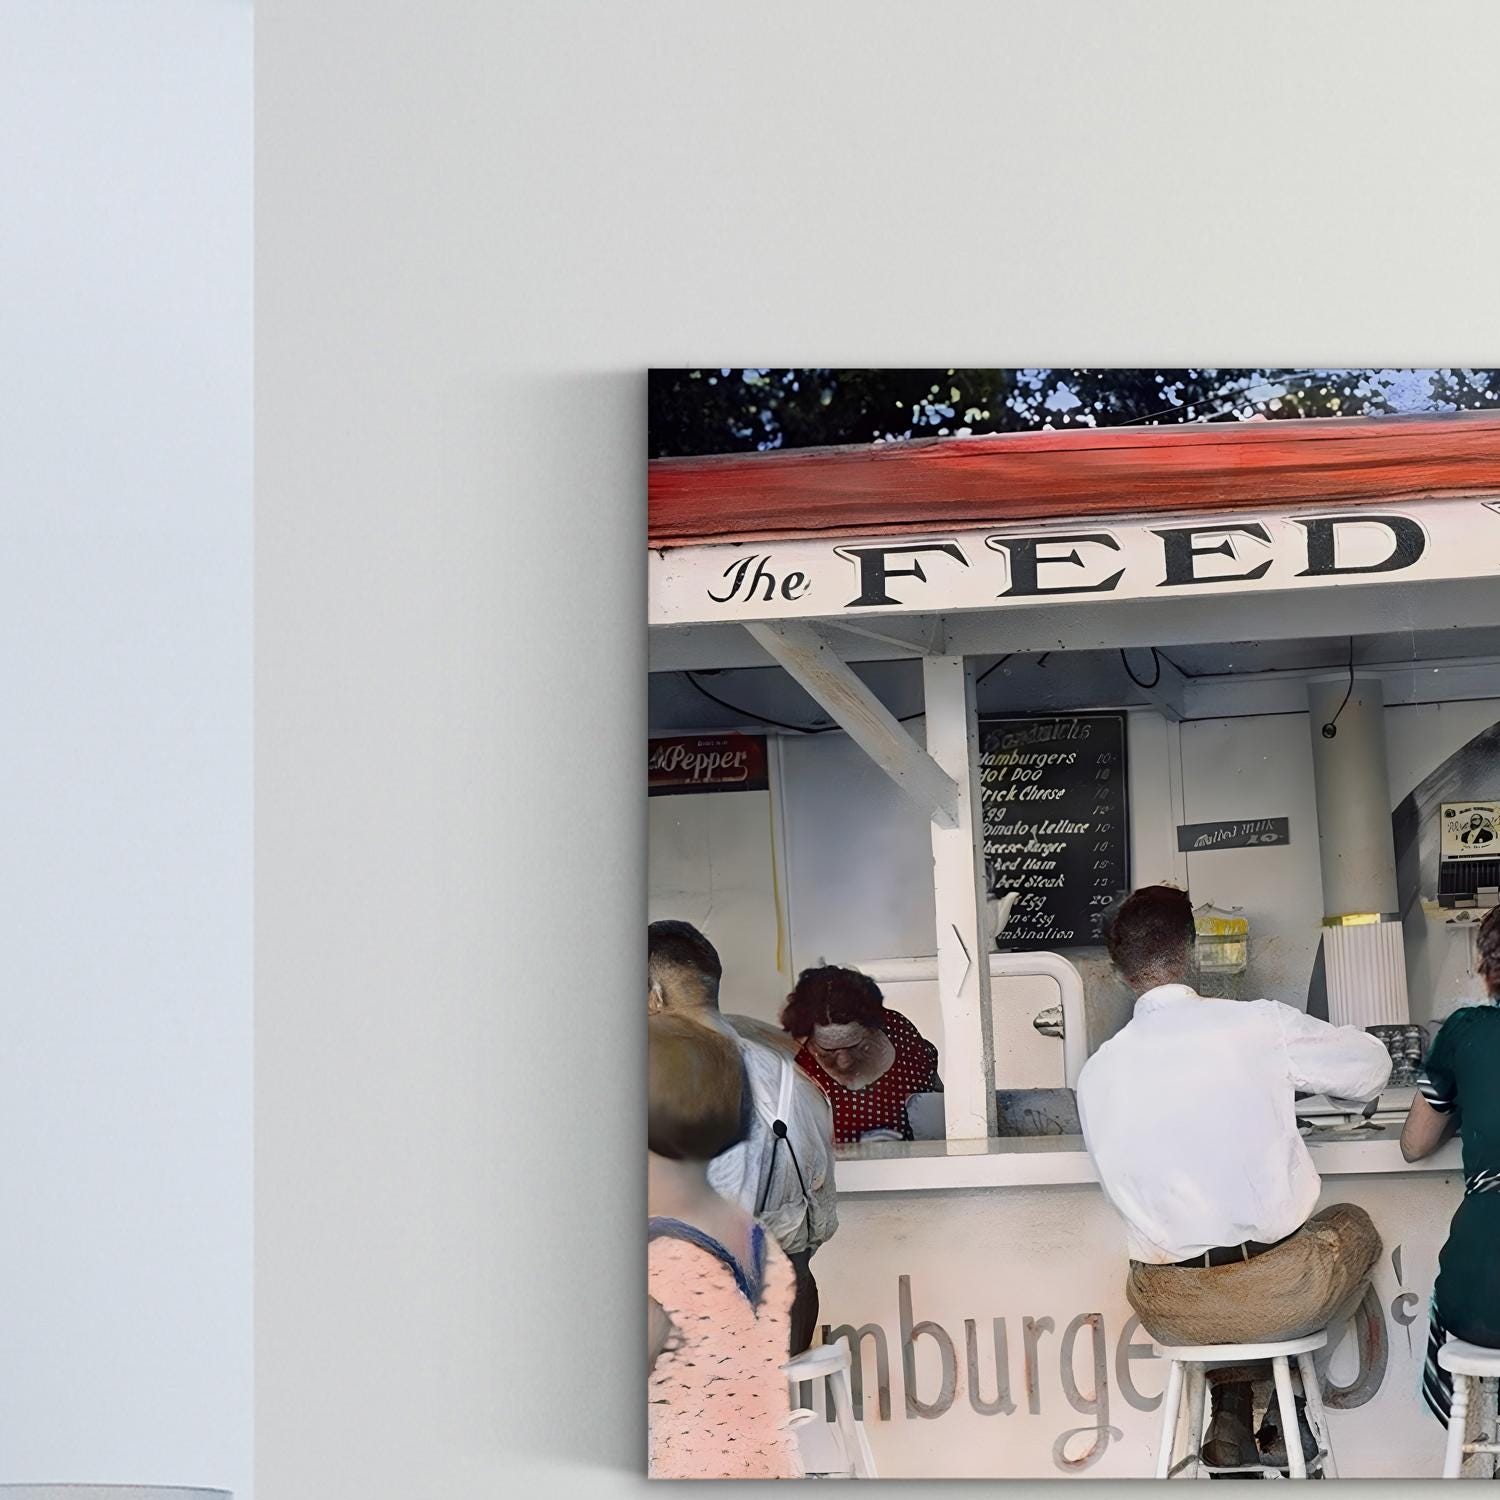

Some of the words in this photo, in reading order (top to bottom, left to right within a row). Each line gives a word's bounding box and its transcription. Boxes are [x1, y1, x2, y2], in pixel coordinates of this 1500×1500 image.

[708, 553, 812, 604] The
[834, 512, 1430, 608] FEED
[662, 744, 748, 781] Pepper
[980, 750, 1077, 768] Hamburgers
